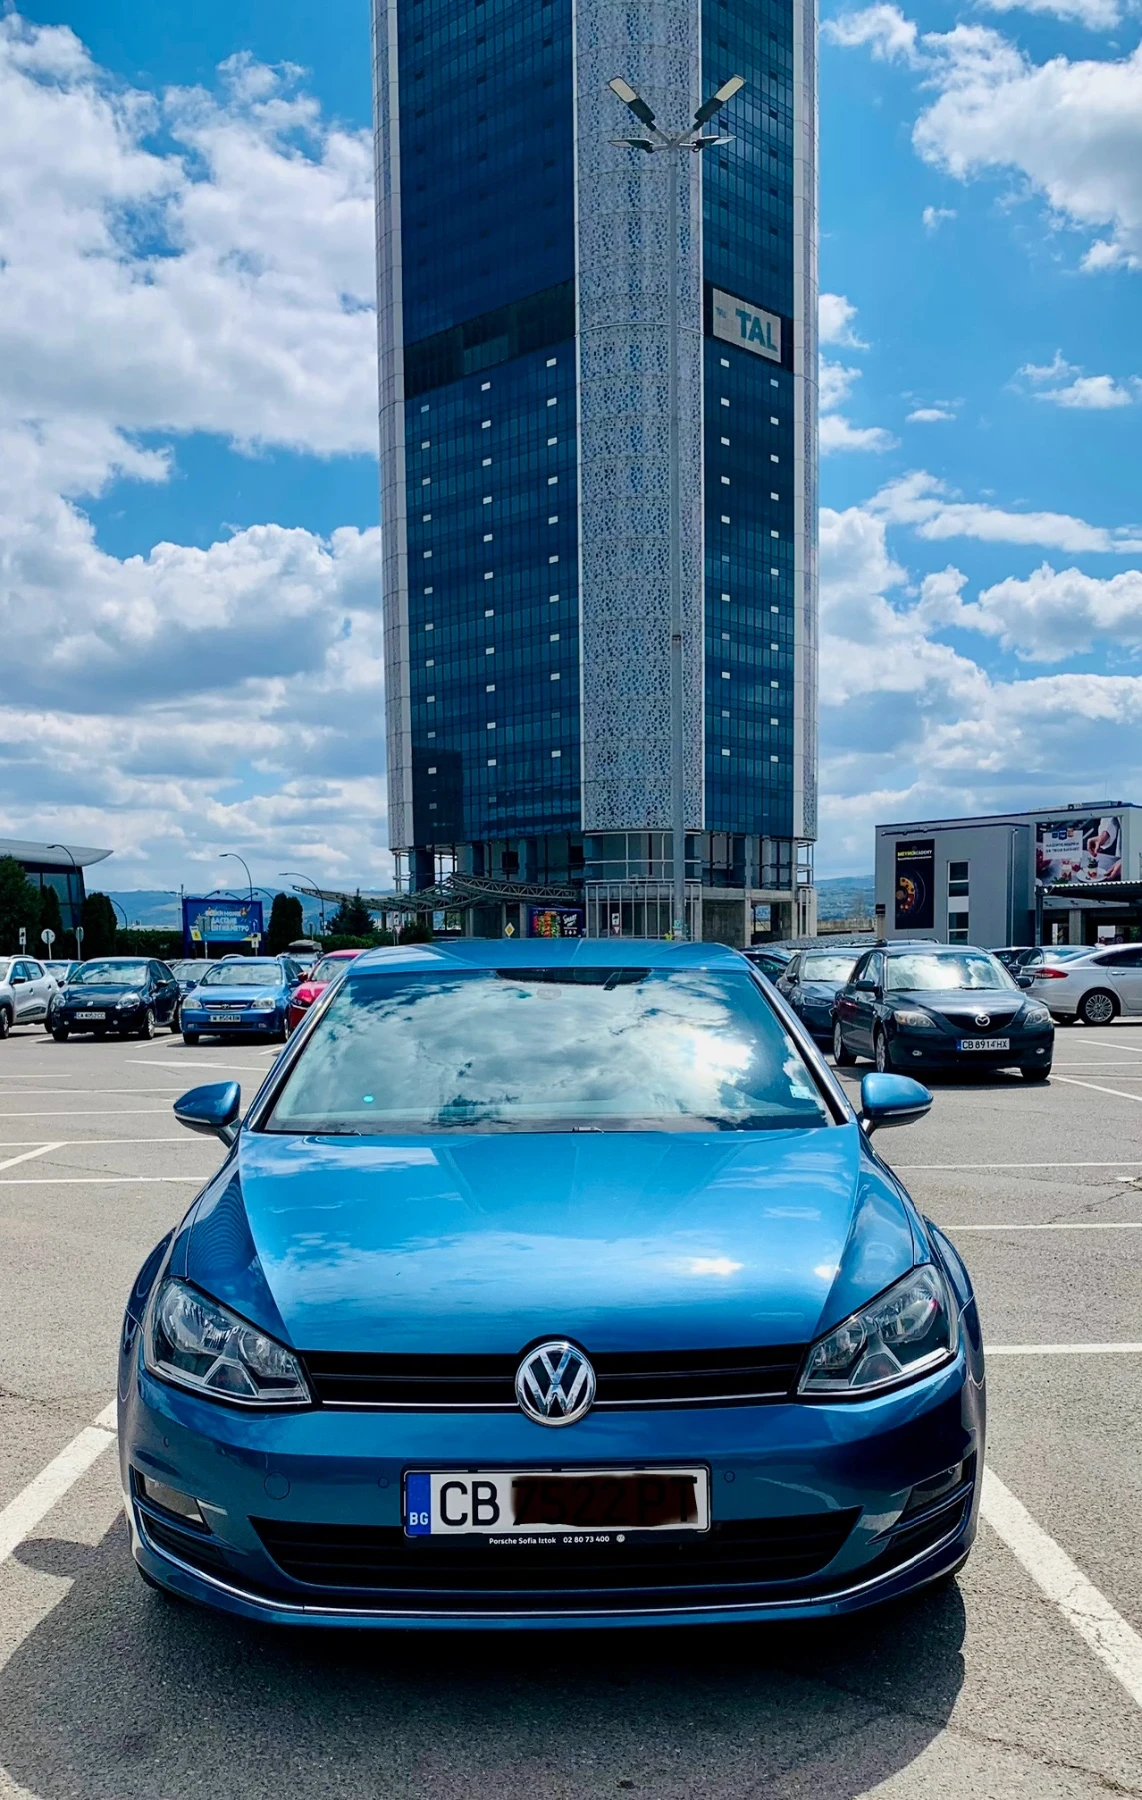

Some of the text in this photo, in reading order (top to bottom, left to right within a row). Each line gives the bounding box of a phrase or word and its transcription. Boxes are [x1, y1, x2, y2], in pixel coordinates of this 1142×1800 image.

[735, 307, 779, 353] TAL
[962, 1040, 974, 1049] CB
[440, 1480, 501, 1527] CB
[409, 1511, 429, 1526] BG
[489, 1537, 517, 1545] Porsche
[518, 1537, 537, 1545] Sofia
[538, 1536, 557, 1544] Iztok
[595, 1535, 610, 1543] 400
